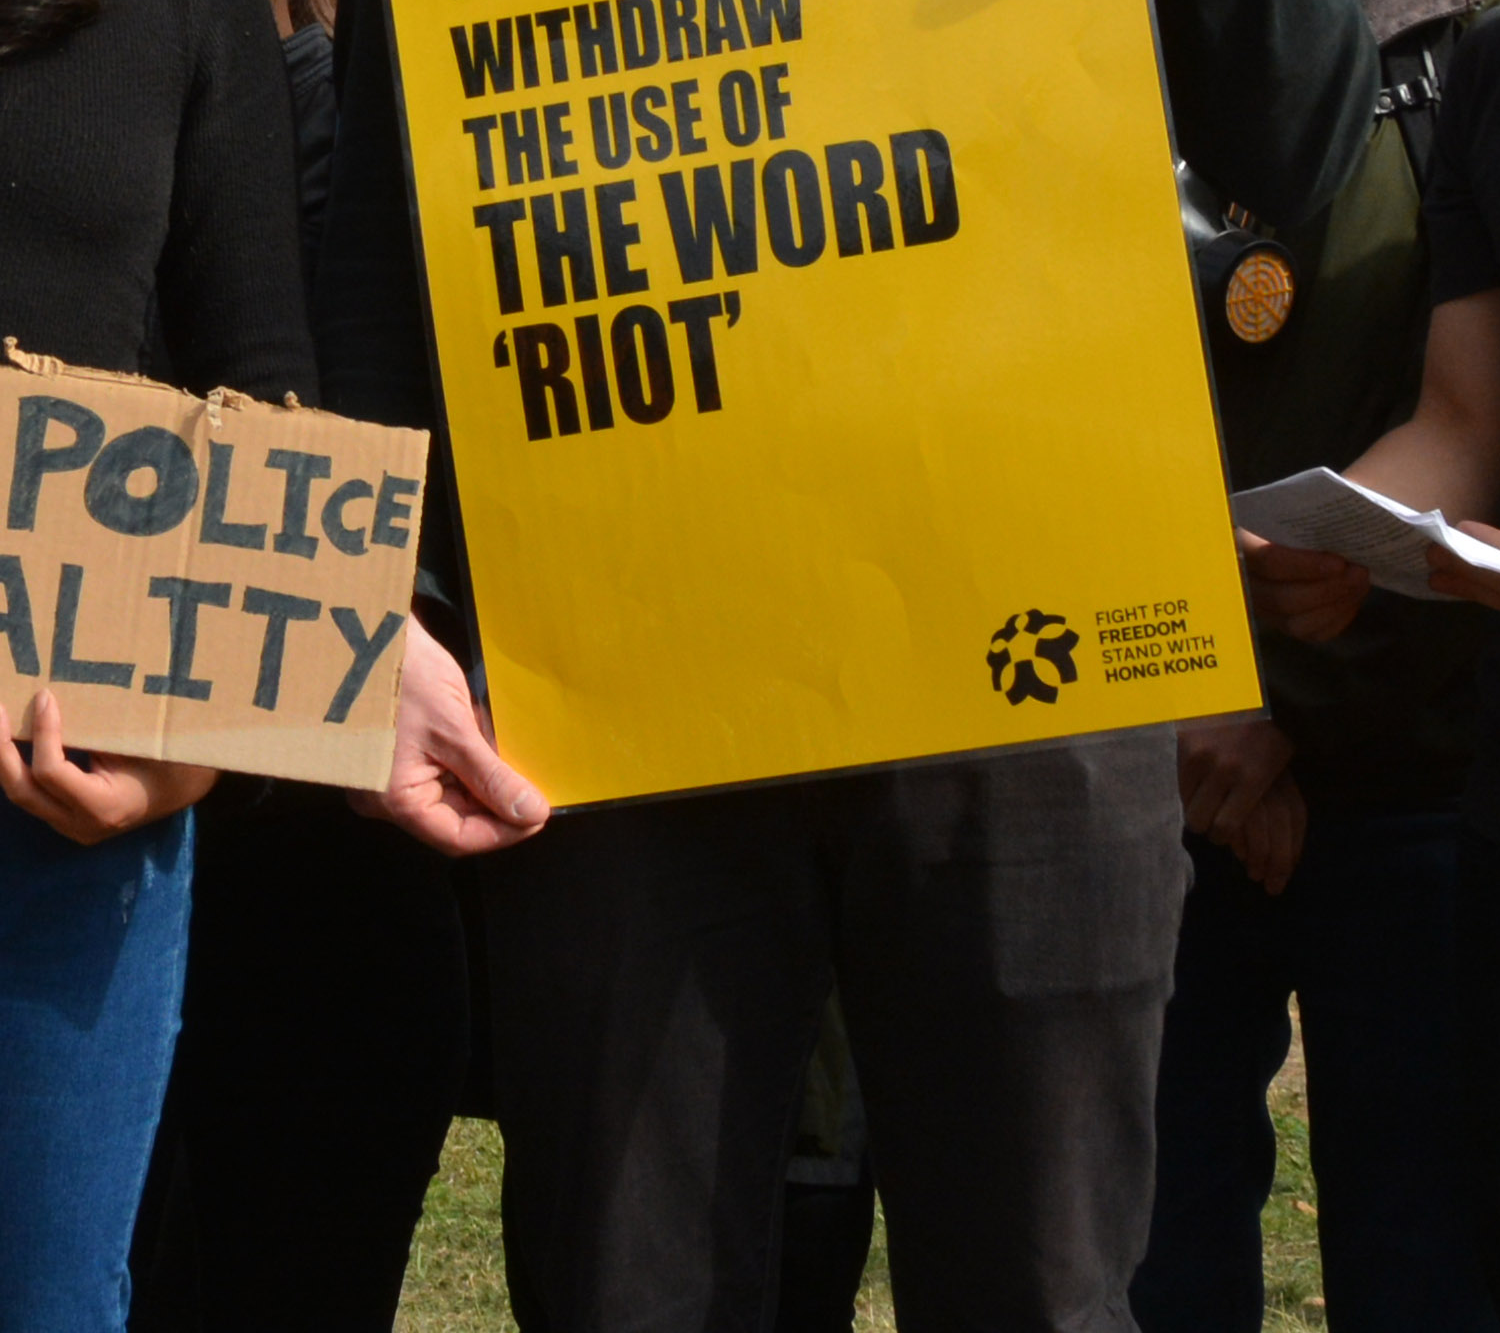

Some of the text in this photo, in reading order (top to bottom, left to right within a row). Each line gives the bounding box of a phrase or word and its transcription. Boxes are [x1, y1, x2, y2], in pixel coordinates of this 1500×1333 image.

[462, 61, 791, 190] THE USE OF
[473, 128, 961, 315] THE WORD
[7, 395, 420, 560] POLICE
[1096, 599, 1189, 625] FIGHT FOR
[1099, 619, 1187, 645] FREEDOM
[1102, 635, 1215, 664] STAND WITH
[1105, 654, 1217, 683] HONG KONG
